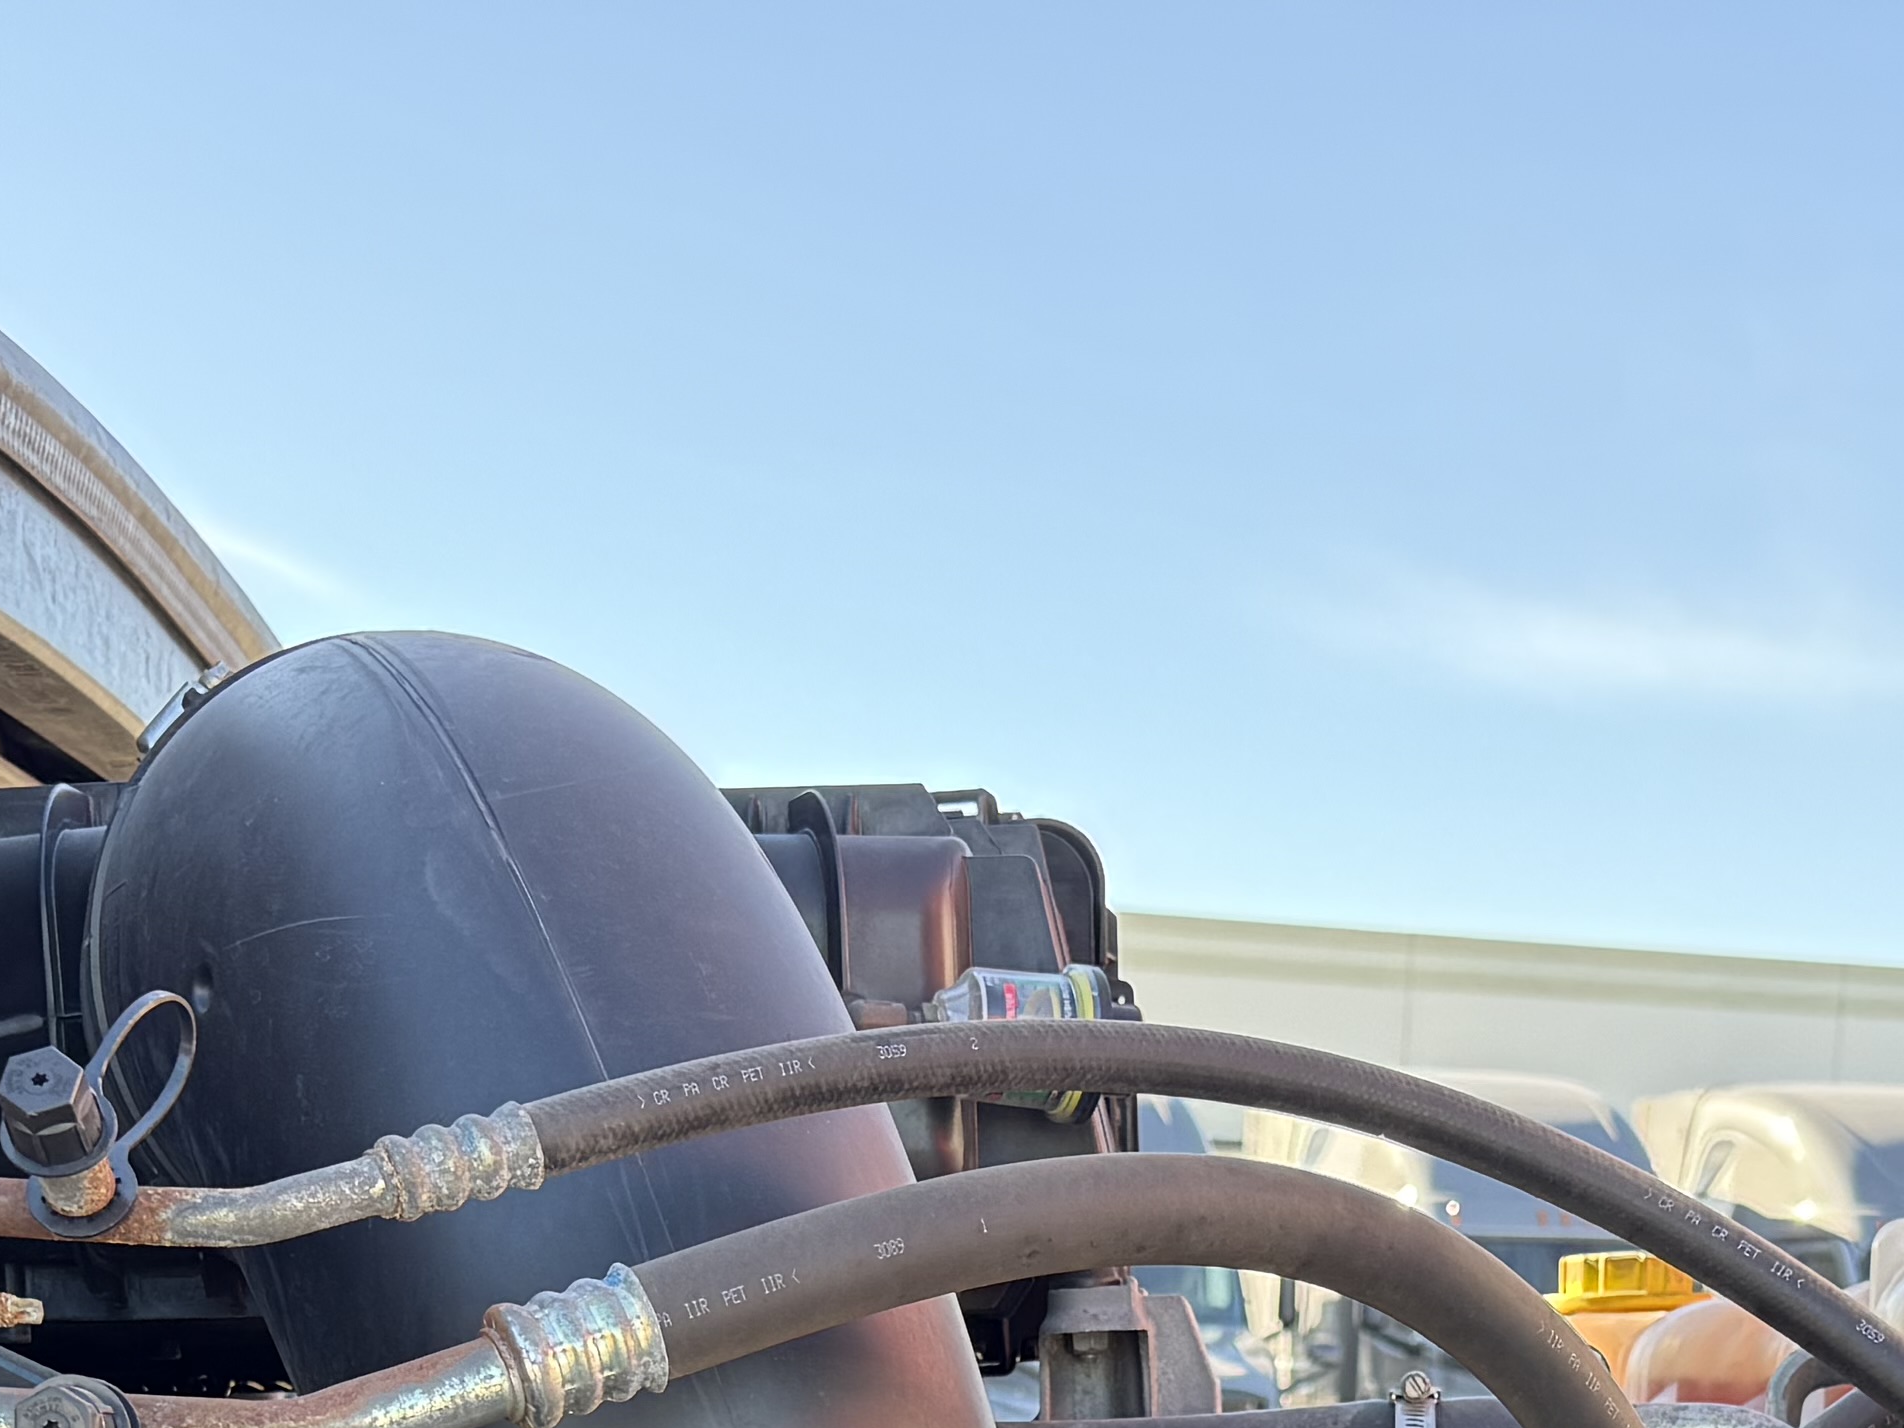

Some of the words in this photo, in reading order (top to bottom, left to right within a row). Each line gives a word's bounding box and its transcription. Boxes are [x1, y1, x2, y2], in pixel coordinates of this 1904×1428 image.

[742, 1067, 764, 1083] PET
[1737, 1240, 1761, 1260] PET
[722, 1285, 747, 1306] PET
